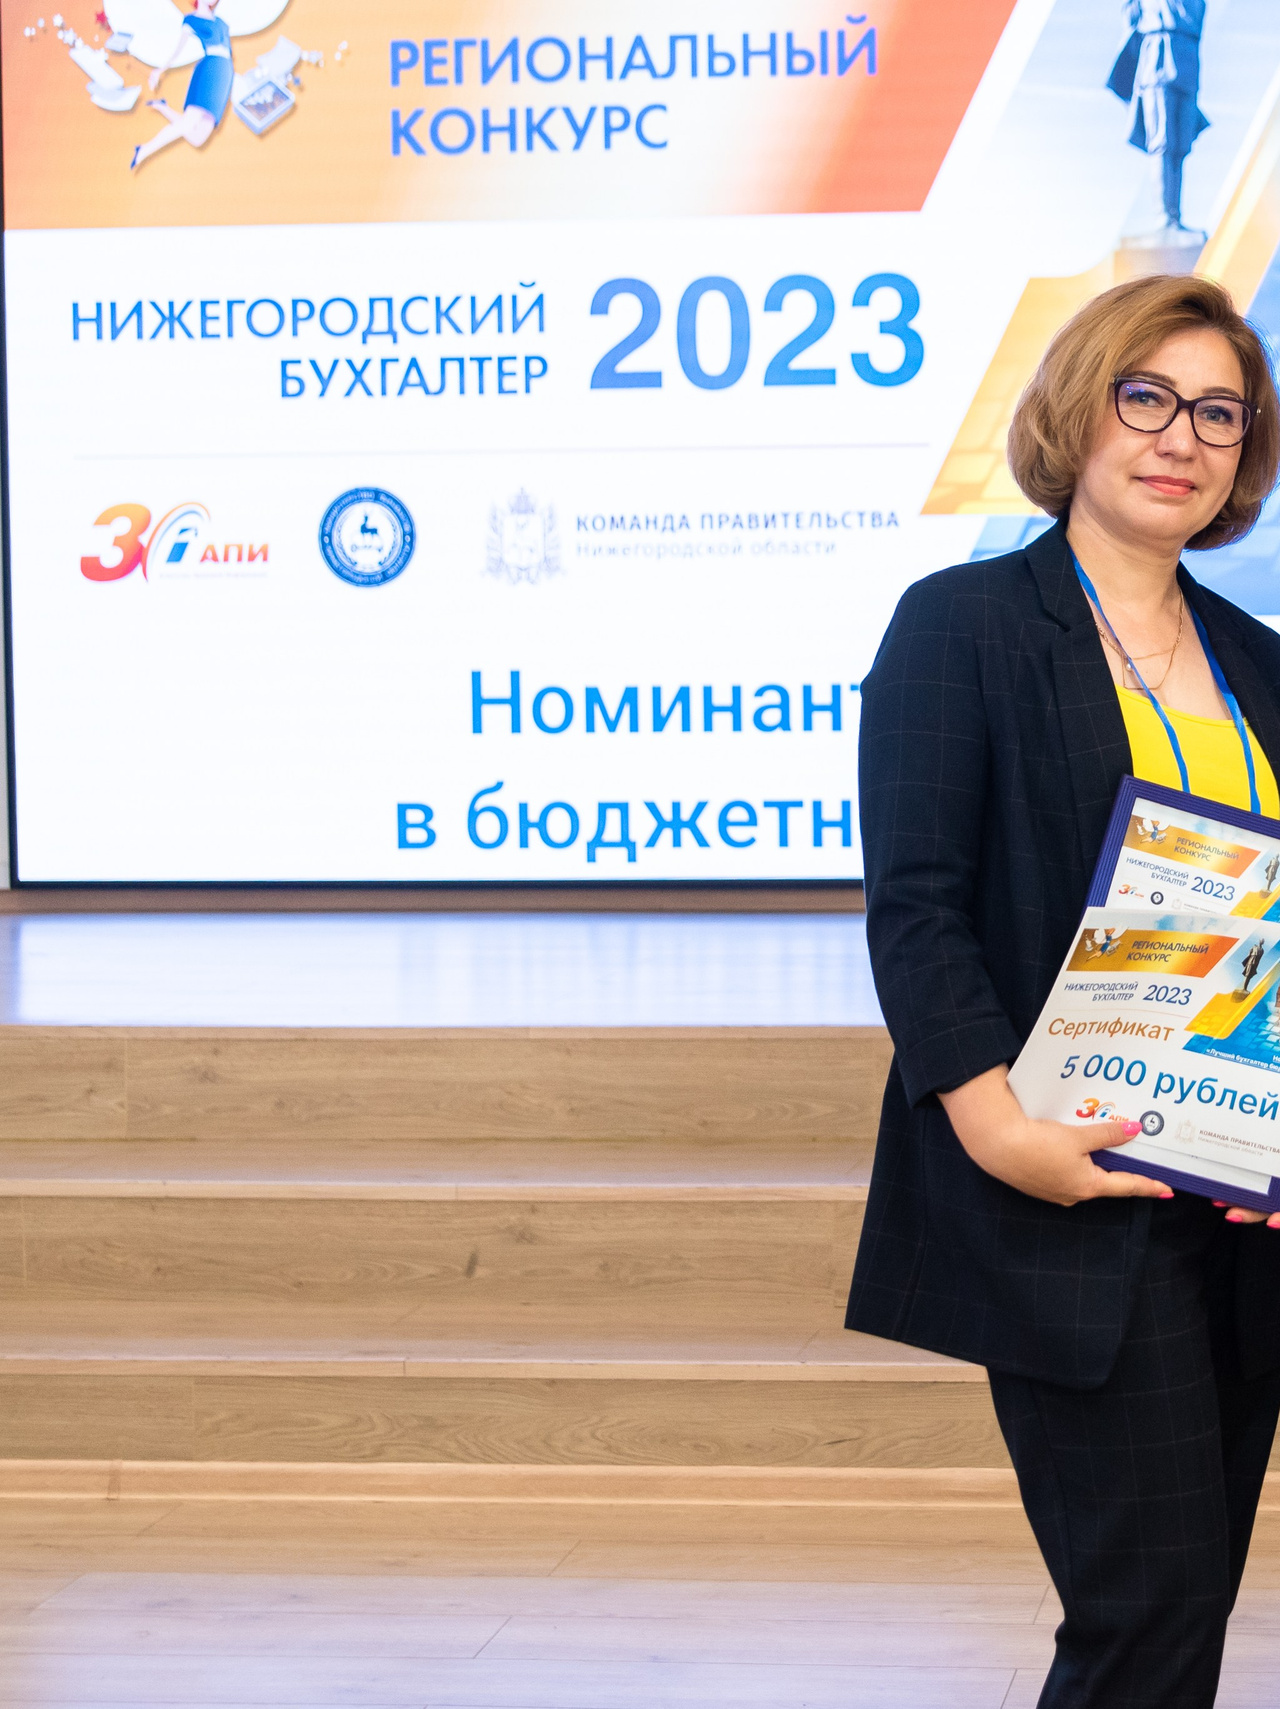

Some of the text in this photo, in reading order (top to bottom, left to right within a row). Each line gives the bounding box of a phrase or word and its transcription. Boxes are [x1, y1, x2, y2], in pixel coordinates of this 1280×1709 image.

[388, 15, 880, 88] РЕГИОНАЛЬНЫЙ
[388, 103, 670, 157] КОНКУРС
[71, 282, 546, 346] НИЖЕГОРОДСКИЙ
[588, 272, 925, 391] 2023
[279, 355, 550, 399] БУХГАЛТЕР
[576, 510, 901, 534] КОМАНДА ПРАВИТЕЛЬСТВА
[199, 543, 270, 564] АПИ
[469, 669, 860, 735] Номинан
[396, 800, 438, 850] в
[1173, 845, 1212, 862] КОНКУРС
[1176, 836, 1240, 860] РЕГИОНАЛЬНЫЙ
[1126, 857, 1190, 880] НИЖЕГОРОДСКИЙ
[1150, 872, 1187, 888] БУХГАЛТЕР
[1190, 876, 1236, 901] 2023
[1126, 952, 1172, 963] КОНКУРС
[1131, 940, 1209, 955] РЕГИОНАЛЬНЫЙ
[1064, 981, 1139, 992] НИЖЕГОРОДСКИЙ
[1092, 992, 1135, 1002] БУХГАЛТЕР
[1142, 984, 1193, 1006] 2023
[1048, 1016, 1175, 1042] Сертификат
[1152, 1070, 1280, 1121] рублей
[1199, 1129, 1280, 1154] КОМАНДА ПРАВИТЕЛЬСТВА
